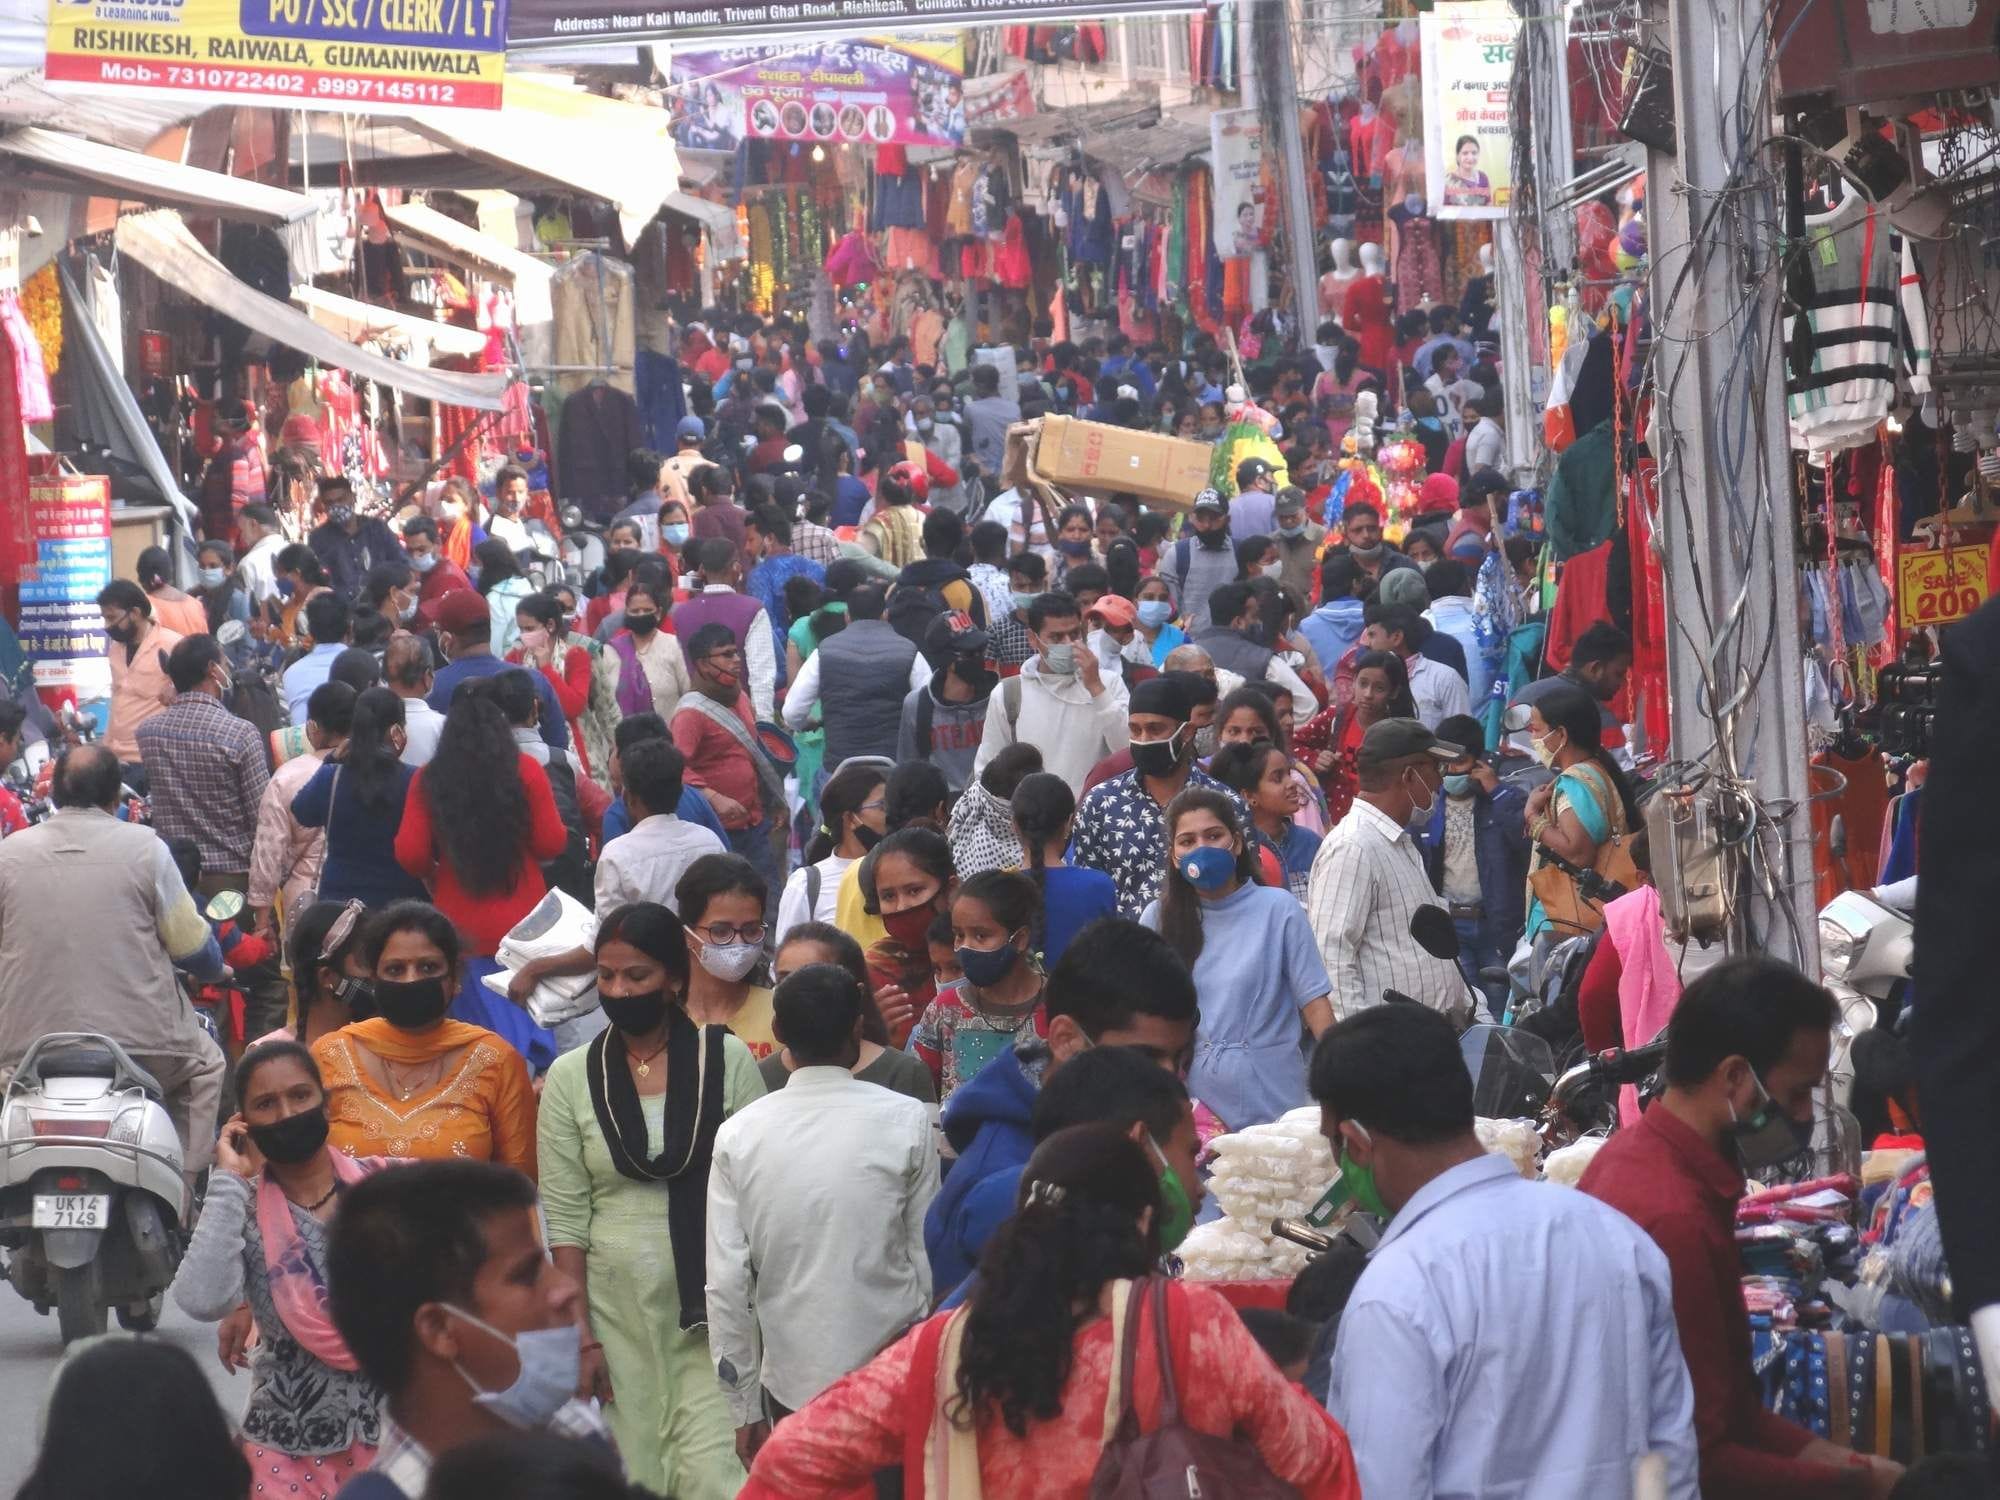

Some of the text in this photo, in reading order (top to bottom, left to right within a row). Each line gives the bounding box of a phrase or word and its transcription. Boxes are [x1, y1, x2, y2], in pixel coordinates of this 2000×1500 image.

[321, 0, 357, 29] SSC
[380, 0, 443, 34] CLERK
[482, 1, 494, 37] T
[554, 17, 609, 32] Address:
[613, 15, 643, 28] Near
[647, 12, 670, 26] Kali
[674, 9, 721, 25] Mandir,
[724, 7, 766, 22] Triveni
[770, 4, 799, 19] Ghat
[74, 27, 481, 75] RISHIKESH, RAIWALA, GUMANIWALA
[101, 62, 160, 81] Mob-
[167, 67, 304, 92] 7310722402
[1917, 587, 1980, 619] 200
[54, 1212, 96, 1226] 7149
